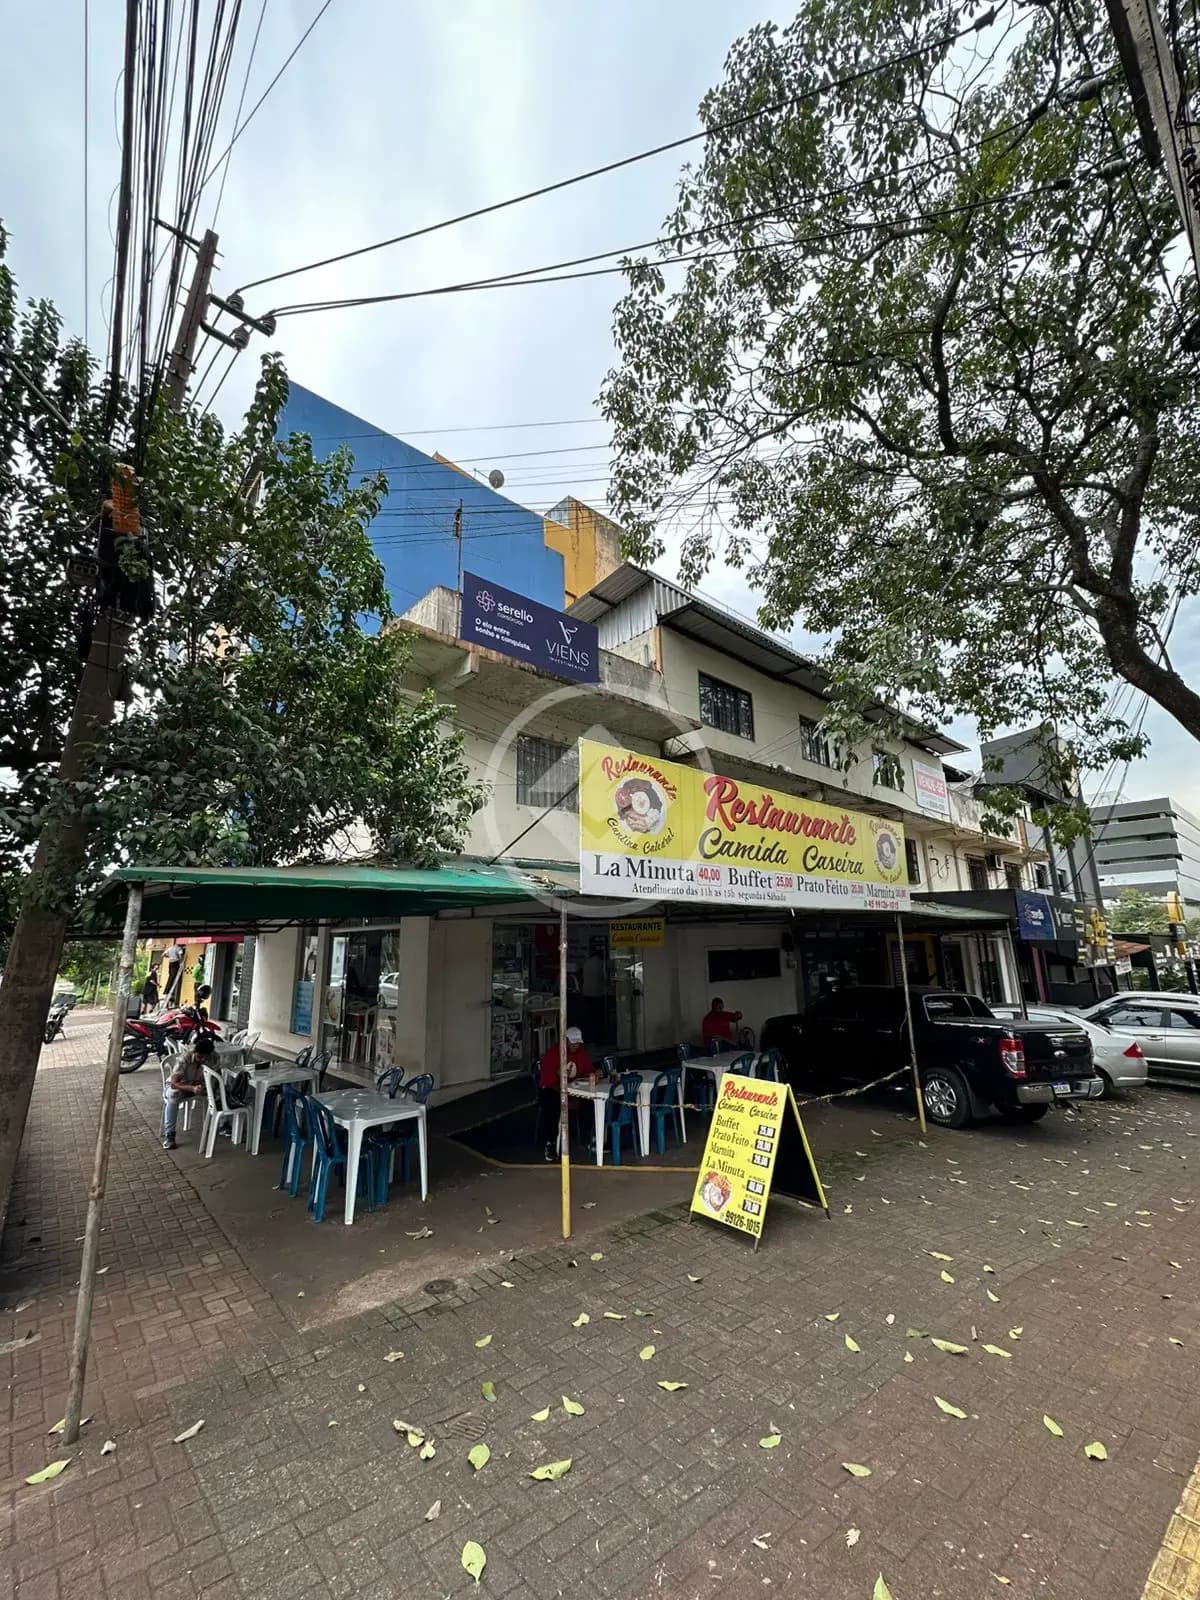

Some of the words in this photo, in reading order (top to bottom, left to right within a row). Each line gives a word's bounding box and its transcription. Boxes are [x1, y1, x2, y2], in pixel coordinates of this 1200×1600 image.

[475, 617, 482, 625] O
[497, 602, 534, 623] serello
[475, 626, 495, 638] sonho
[546, 639, 590, 667] VIENS
[602, 752, 678, 802] Restaurante
[703, 775, 858, 847] Restaurante
[606, 817, 639, 851] Cantina
[802, 845, 865, 875] Caseira
[594, 854, 621, 878] La
[625, 856, 694, 882] Minuta
[698, 866, 721, 882] 40,00
[727, 867, 773, 889] Buffet
[797, 875, 824, 893] Prato
[825, 879, 849, 895] Feito
[866, 884, 895, 899] Marmita
[632, 882, 684, 895] Atendimento
[686, 885, 698, 896] das
[611, 922, 662, 931] RESTAURANTE
[723, 1080, 778, 1106] Restaurante
[716, 1115, 740, 1131] Buffet
[749, 1105, 778, 1121] Caseira
[712, 1127, 731, 1142] Prato
[731, 1132, 750, 1147] Feito
[710, 1141, 736, 1159] Marmita
[706, 1155, 716, 1169] La
[717, 1159, 746, 1179] Minuta
[724, 1210, 761, 1235] 99126-1015
